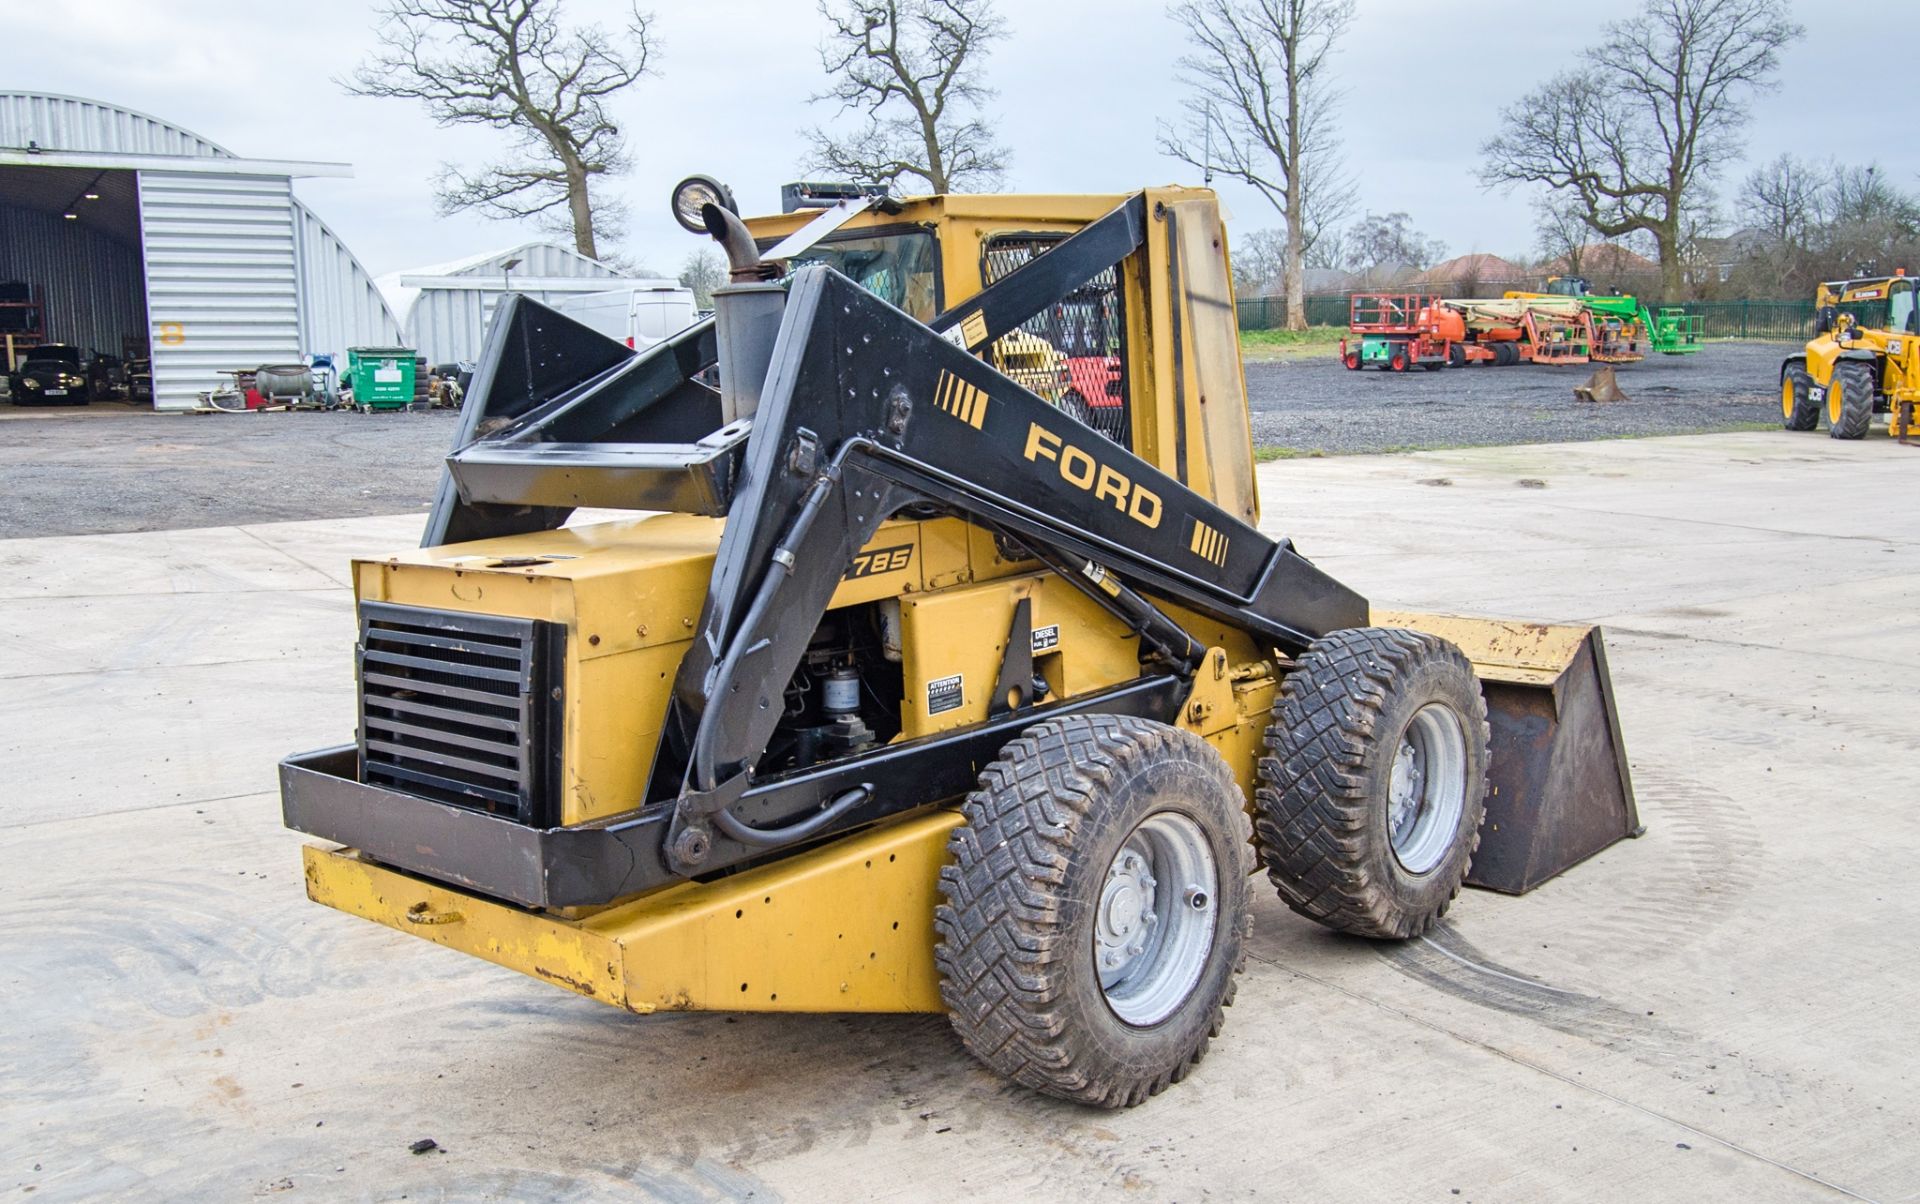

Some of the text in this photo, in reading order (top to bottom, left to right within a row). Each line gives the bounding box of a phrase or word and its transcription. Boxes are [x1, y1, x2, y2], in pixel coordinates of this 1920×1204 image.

[160, 321, 186, 346] 8
[1024, 421, 1163, 529] FORD
[840, 548, 911, 582] 785
[1035, 627, 1056, 640] DIESEL
[930, 676, 960, 690] ATTENTION
